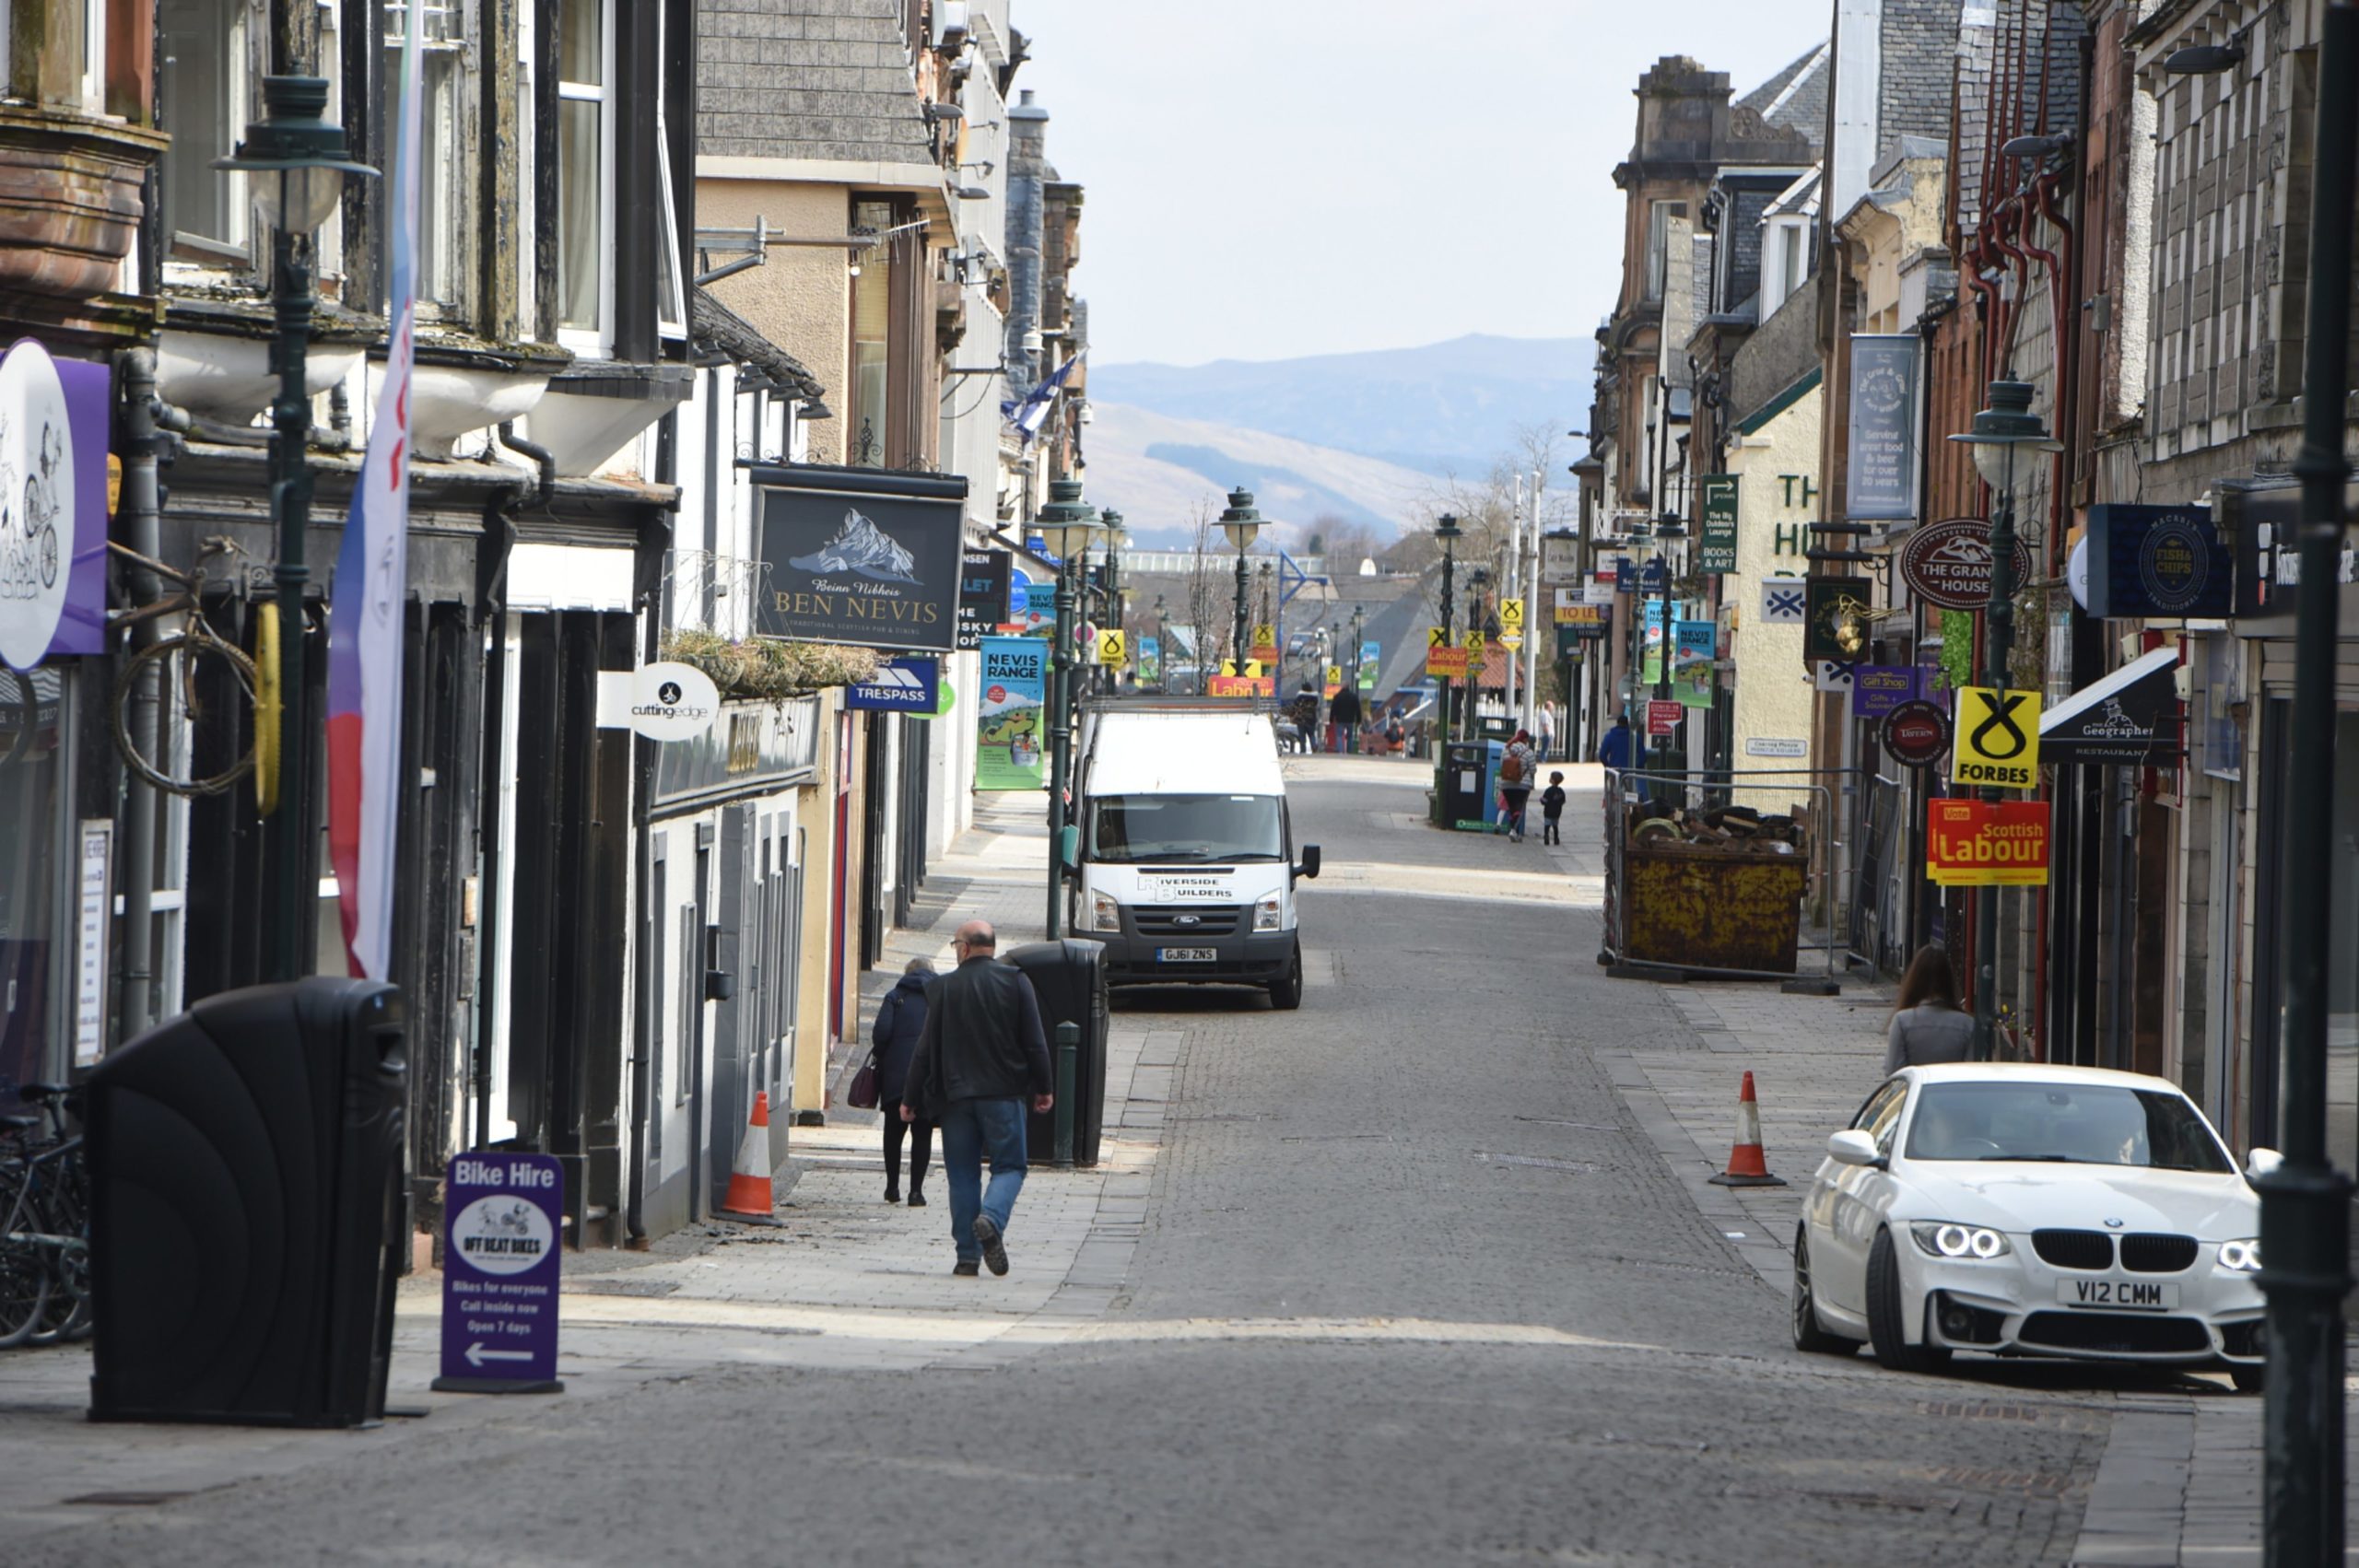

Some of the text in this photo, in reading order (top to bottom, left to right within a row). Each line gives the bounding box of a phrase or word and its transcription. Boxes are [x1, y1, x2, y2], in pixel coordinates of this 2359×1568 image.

[1884, 442, 1904, 452] food
[1866, 453, 1897, 463] & beer
[1863, 465, 1898, 474] for over
[1875, 477, 1899, 486] years
[1722, 512, 1732, 521] Big
[1708, 529, 1732, 537] Lounge
[1703, 547, 1734, 557] BOOKS
[962, 554, 991, 564] NSEN
[1705, 558, 1732, 568] & ART
[1920, 564, 1991, 578] THE GRAN
[2155, 562, 2191, 574] CHIPS
[812, 579, 901, 597] Beinn Nibheis
[963, 578, 993, 592] LET
[1942, 580, 1990, 592] HOUSE
[2147, 591, 2200, 610] TRADITIONAL
[774, 591, 937, 624] BEN NEVIS
[1562, 607, 1596, 618] TO LE
[790, 619, 834, 628] TRADITIONAL
[838, 623, 870, 632] SCOTTISH
[988, 653, 1039, 666] NEVIS
[1429, 649, 1466, 661] Labour
[987, 665, 1038, 679] RANGE
[1863, 676, 1906, 688] Gift Shop
[856, 687, 926, 702] TRESPASS
[1871, 694, 1888, 702] Gifts
[2083, 725, 2153, 739] Geographer
[2076, 747, 2149, 756] RESTAURANT
[1959, 764, 2030, 784] FORBES
[1944, 809, 1969, 819] Vote
[1982, 822, 2044, 837] Scottish
[1939, 833, 2044, 861] Labour
[1166, 950, 1213, 960] GJ61 ZNS
[454, 1161, 555, 1188] Bike Hire
[464, 1236, 541, 1254] OFF BEAT BIKES
[452, 1280, 549, 1297] Bikes for everyone
[2076, 1281, 2161, 1305] V12 CMM
[461, 1300, 539, 1315] Call inside now
[467, 1319, 532, 1336] Open 7 days
